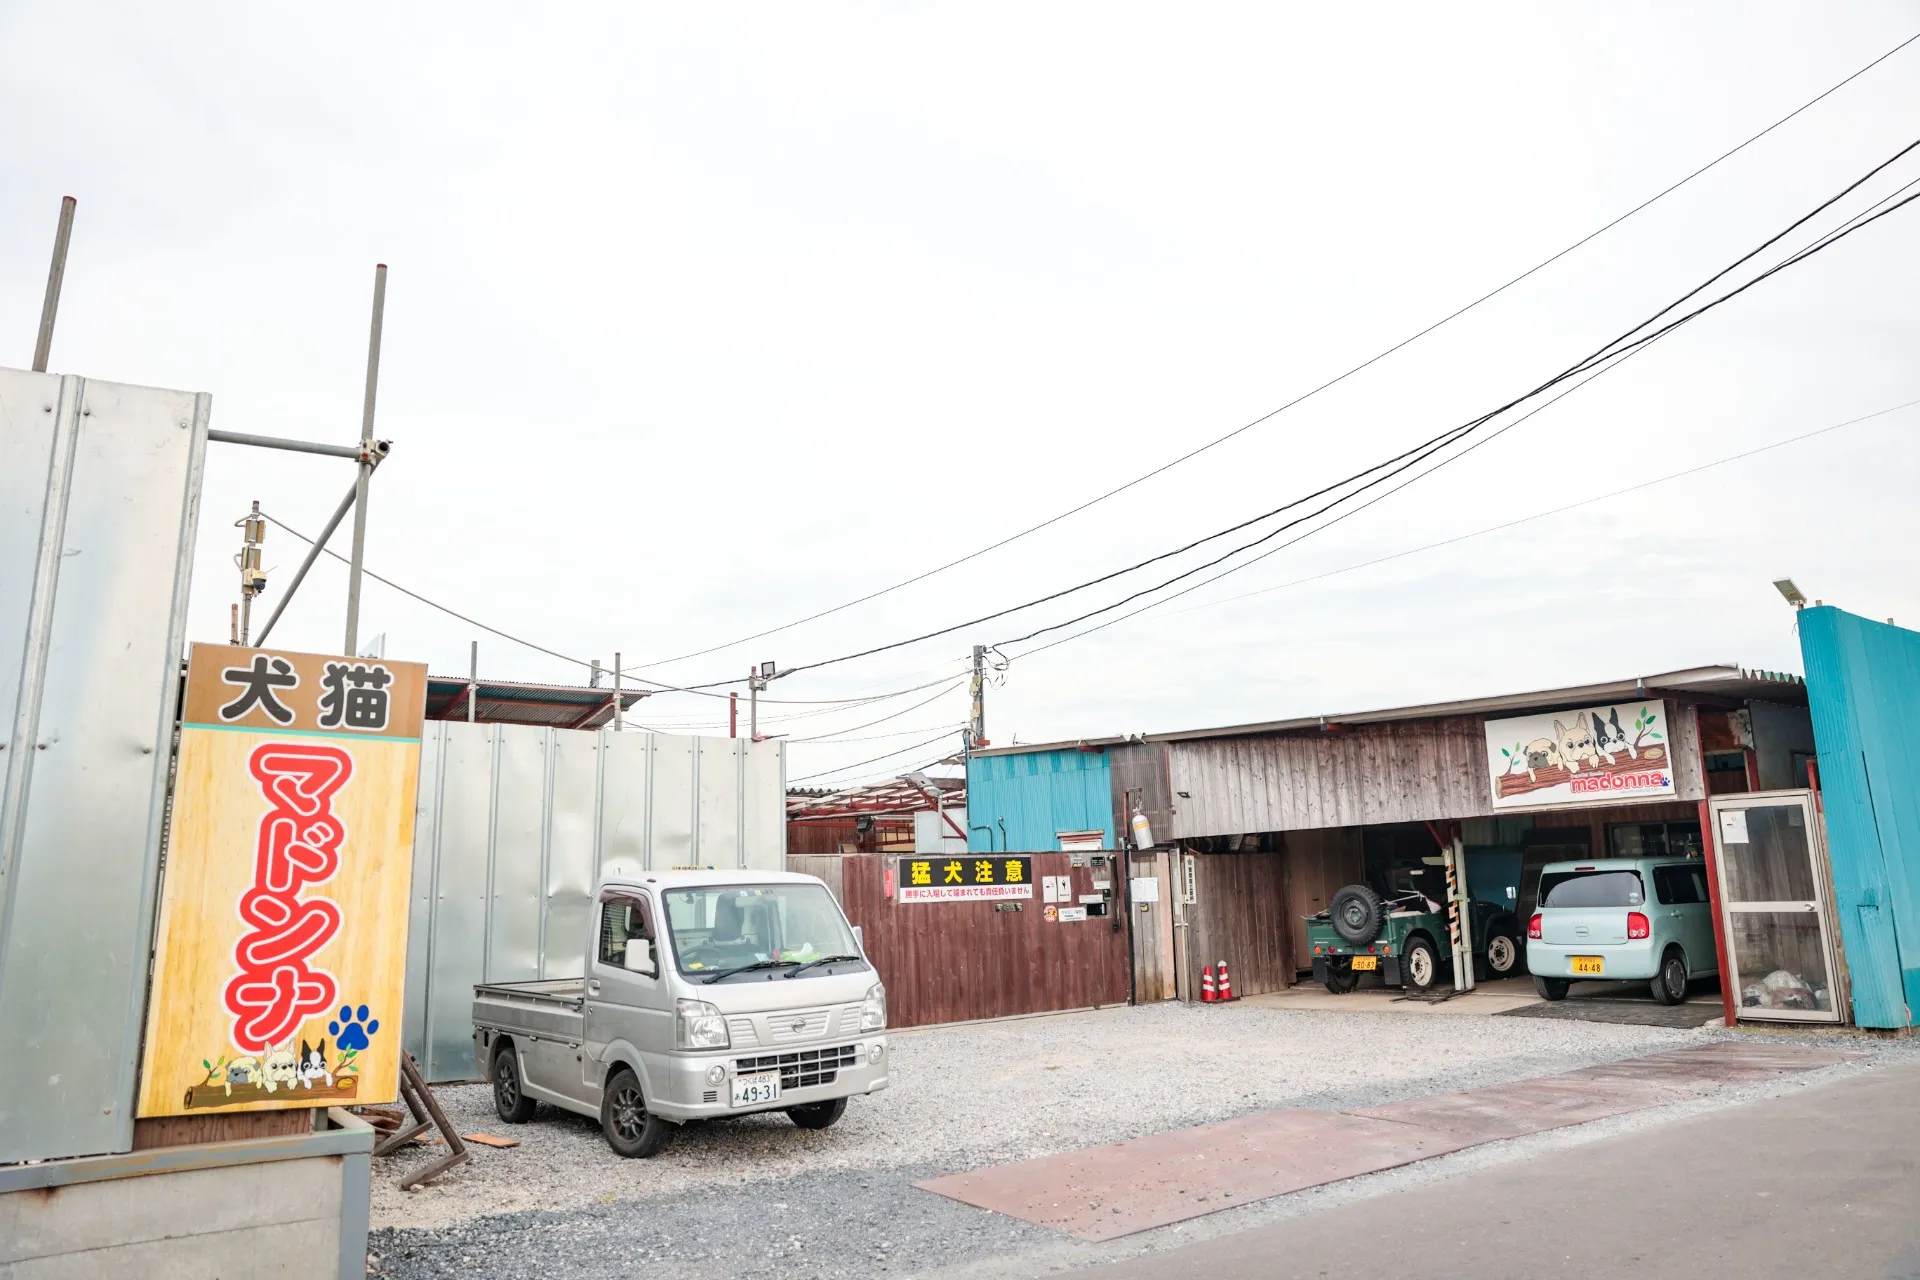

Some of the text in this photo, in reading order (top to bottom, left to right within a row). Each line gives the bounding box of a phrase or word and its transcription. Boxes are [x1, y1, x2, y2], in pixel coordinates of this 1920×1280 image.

[1570, 772, 1663, 793] madonna
[911, 860, 1024, 885] 猛犬注意
[225, 742, 353, 1054] マドンナ
[742, 1083, 777, 1103] 49-31
